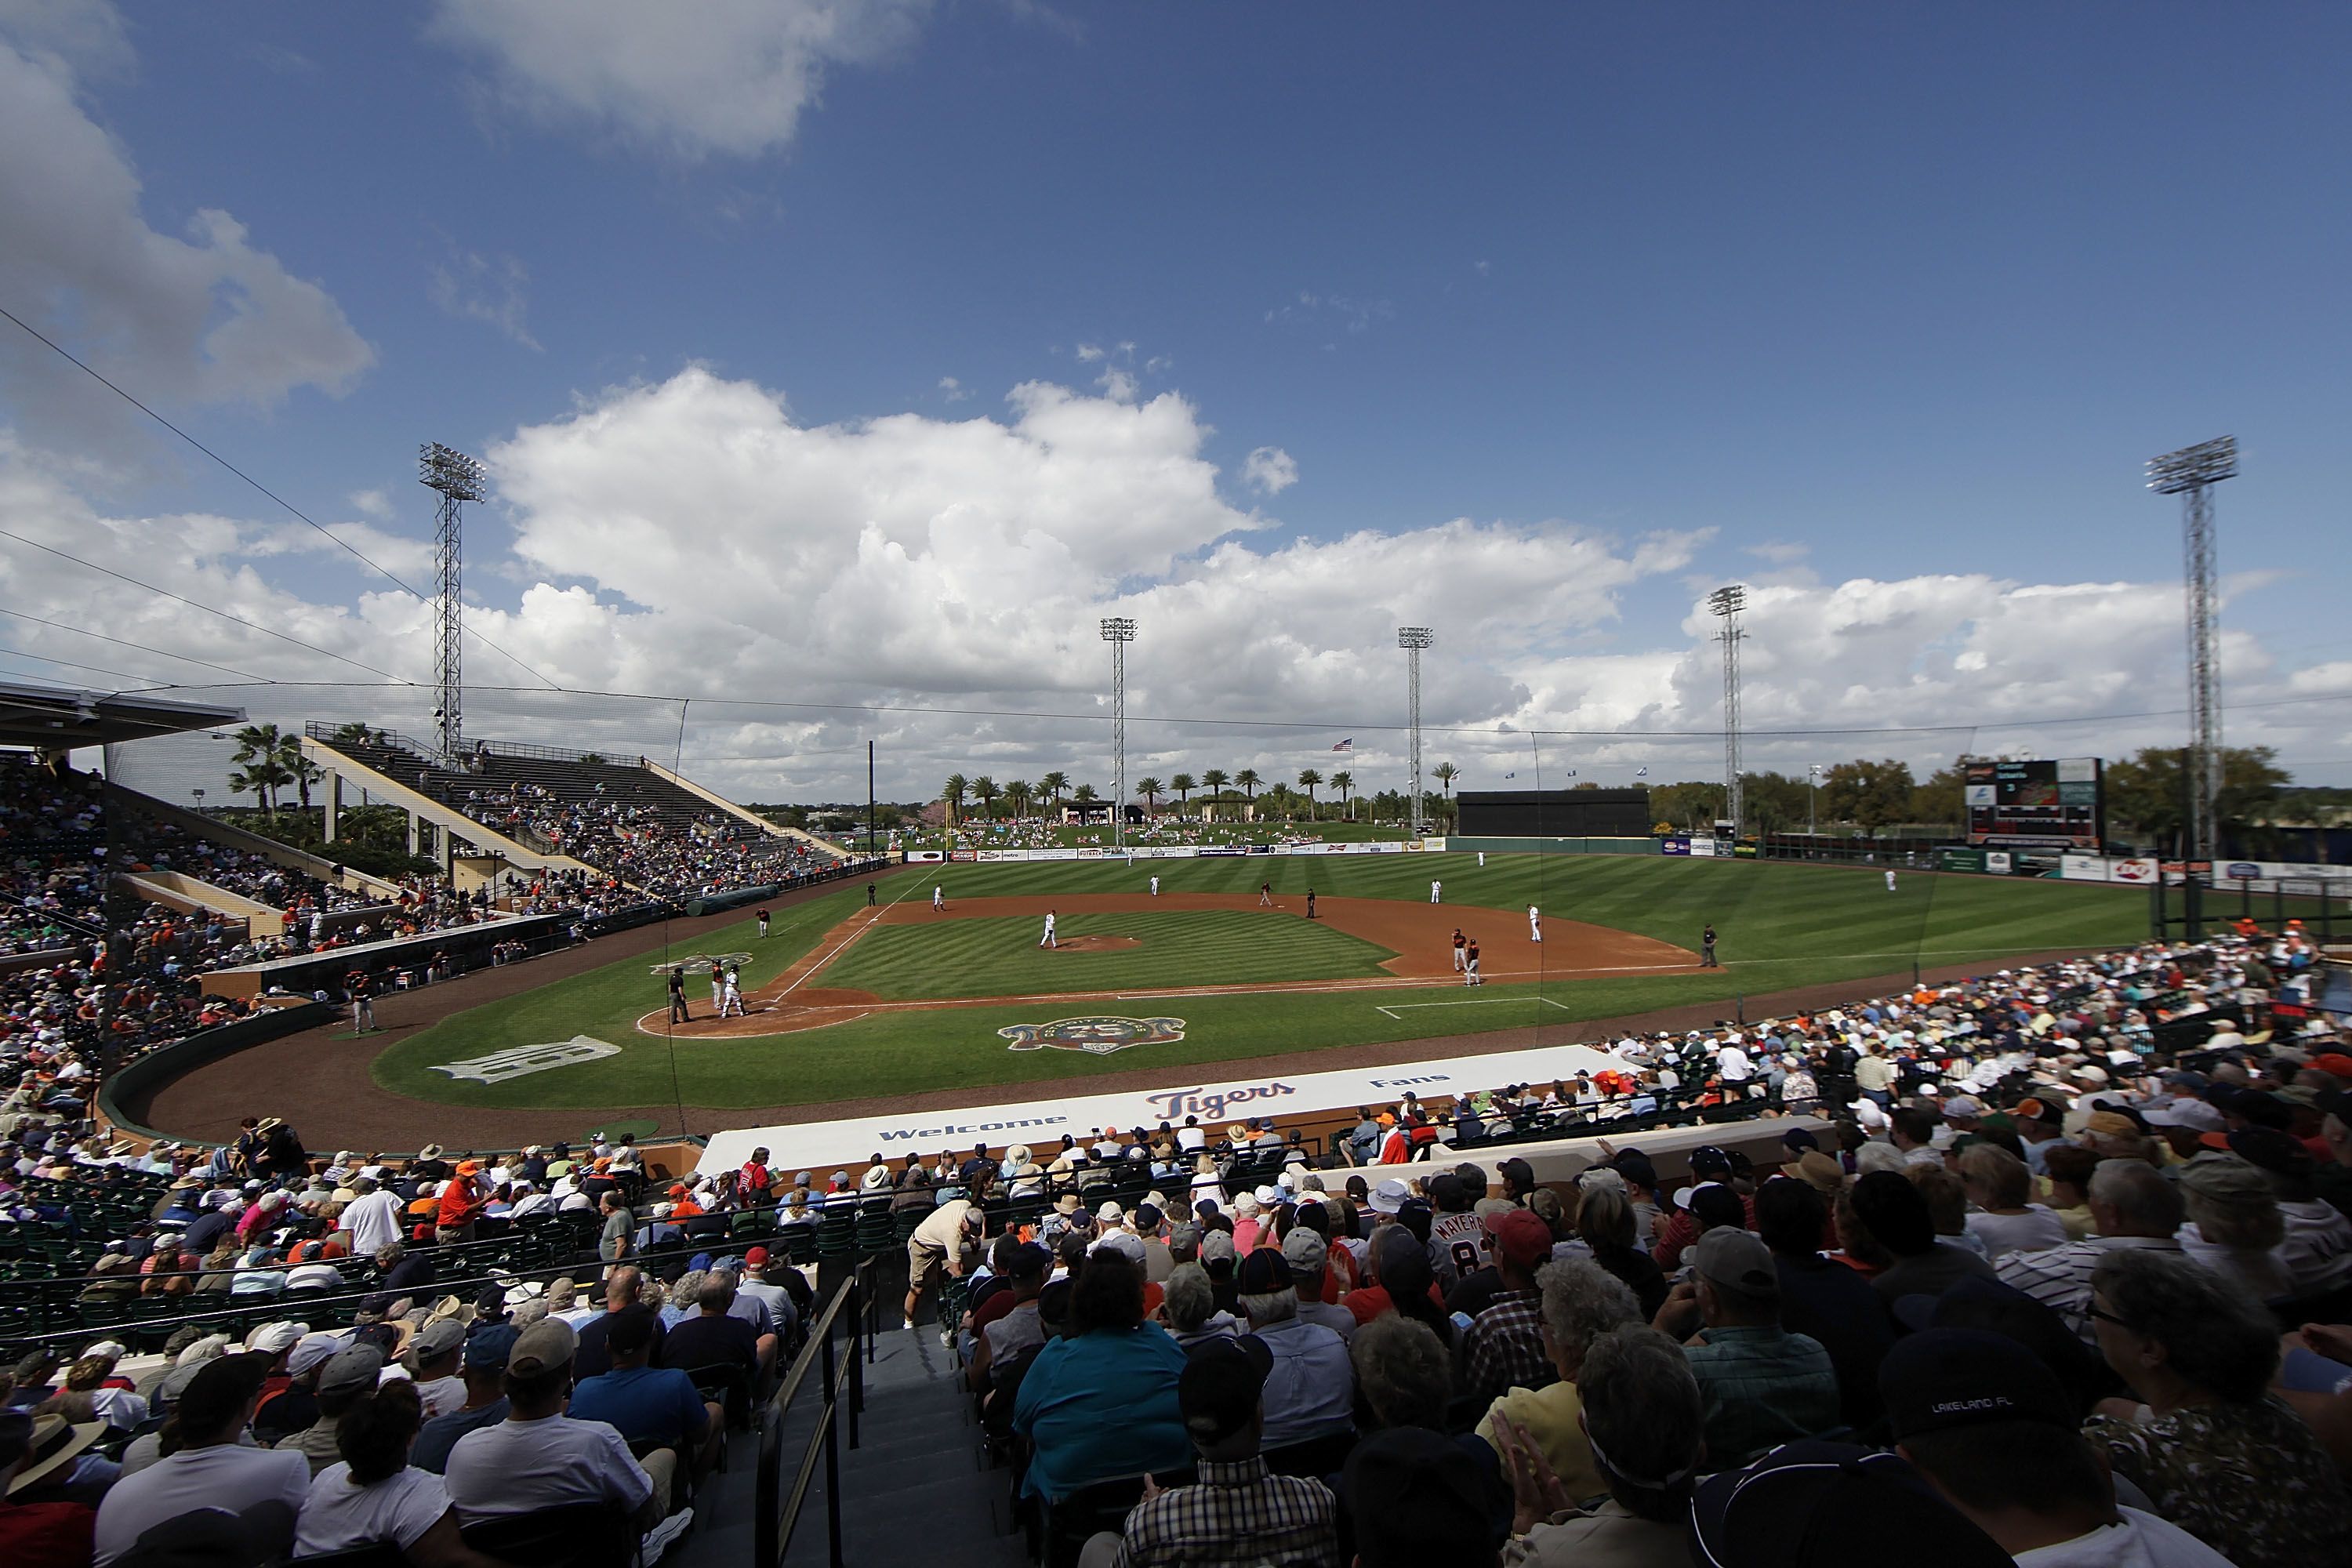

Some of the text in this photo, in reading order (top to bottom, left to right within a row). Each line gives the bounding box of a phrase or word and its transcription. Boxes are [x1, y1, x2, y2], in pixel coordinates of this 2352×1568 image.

[1044, 1018, 1147, 1037] DETROIT TIGERS
[878, 1074, 1451, 1141] Welcome Tigers Fans
[1932, 1396, 2013, 1413] LAKELAND FL
